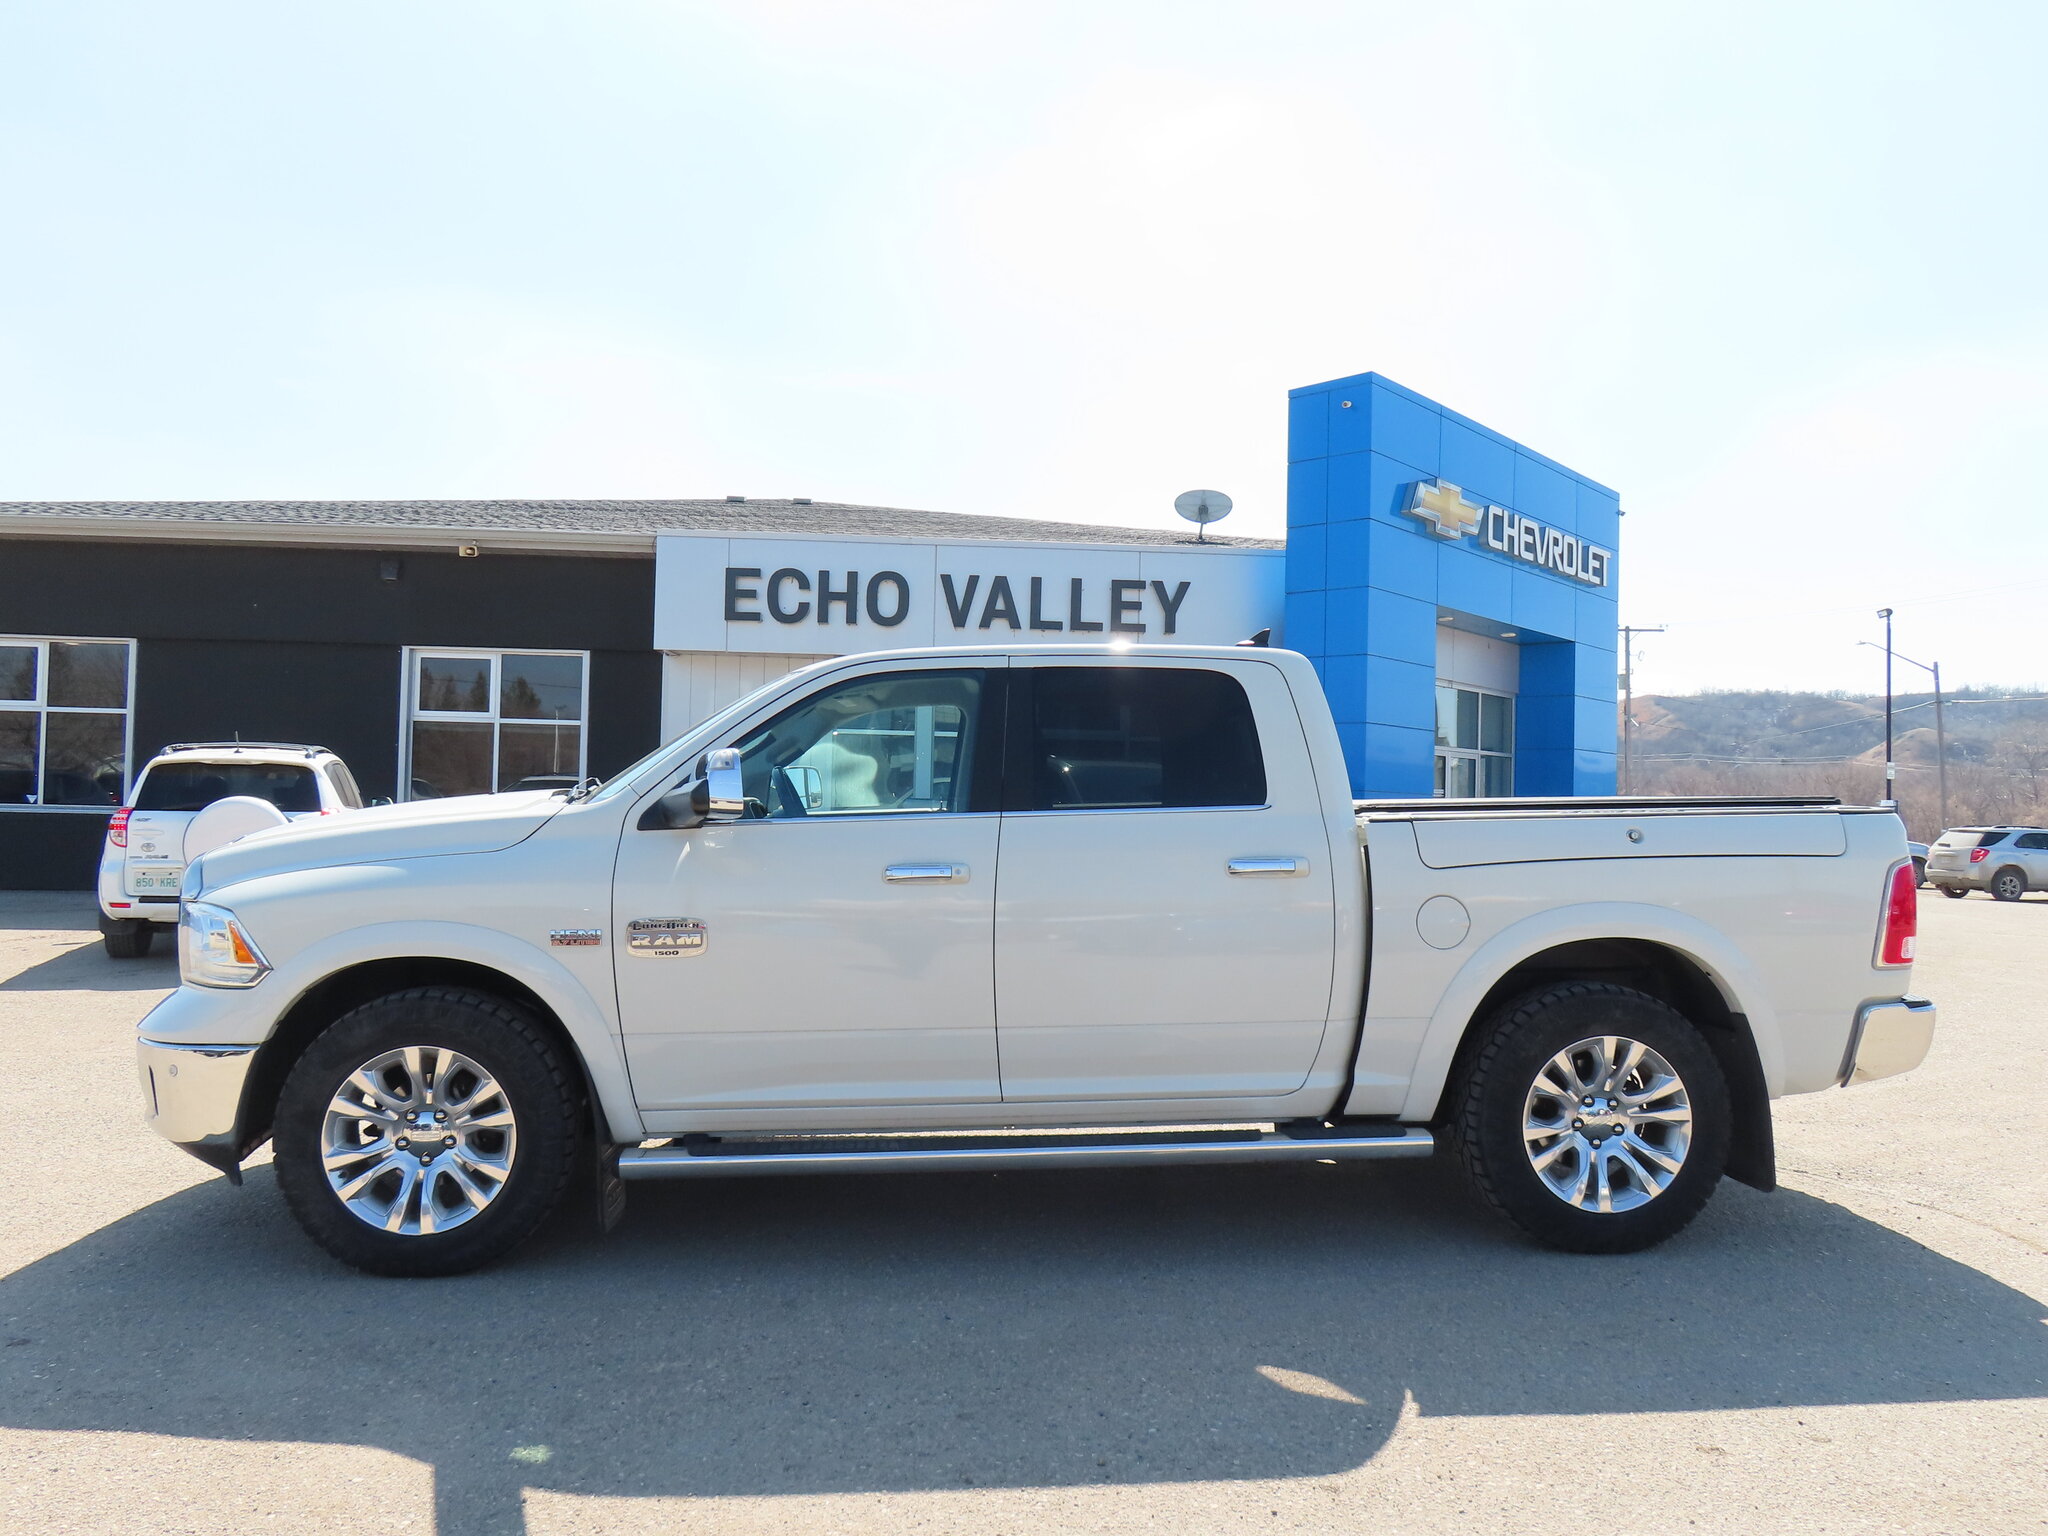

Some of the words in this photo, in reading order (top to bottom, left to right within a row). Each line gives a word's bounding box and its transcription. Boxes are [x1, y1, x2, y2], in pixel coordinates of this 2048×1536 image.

[1487, 504, 1612, 588] CHEVROLET
[724, 566, 910, 627] ECHO
[940, 573, 1192, 635] VALLEY
[136, 877, 154, 888] 850
[159, 877, 178, 888] KRE
[549, 929, 602, 939] HEMI
[631, 933, 702, 946] RAM
